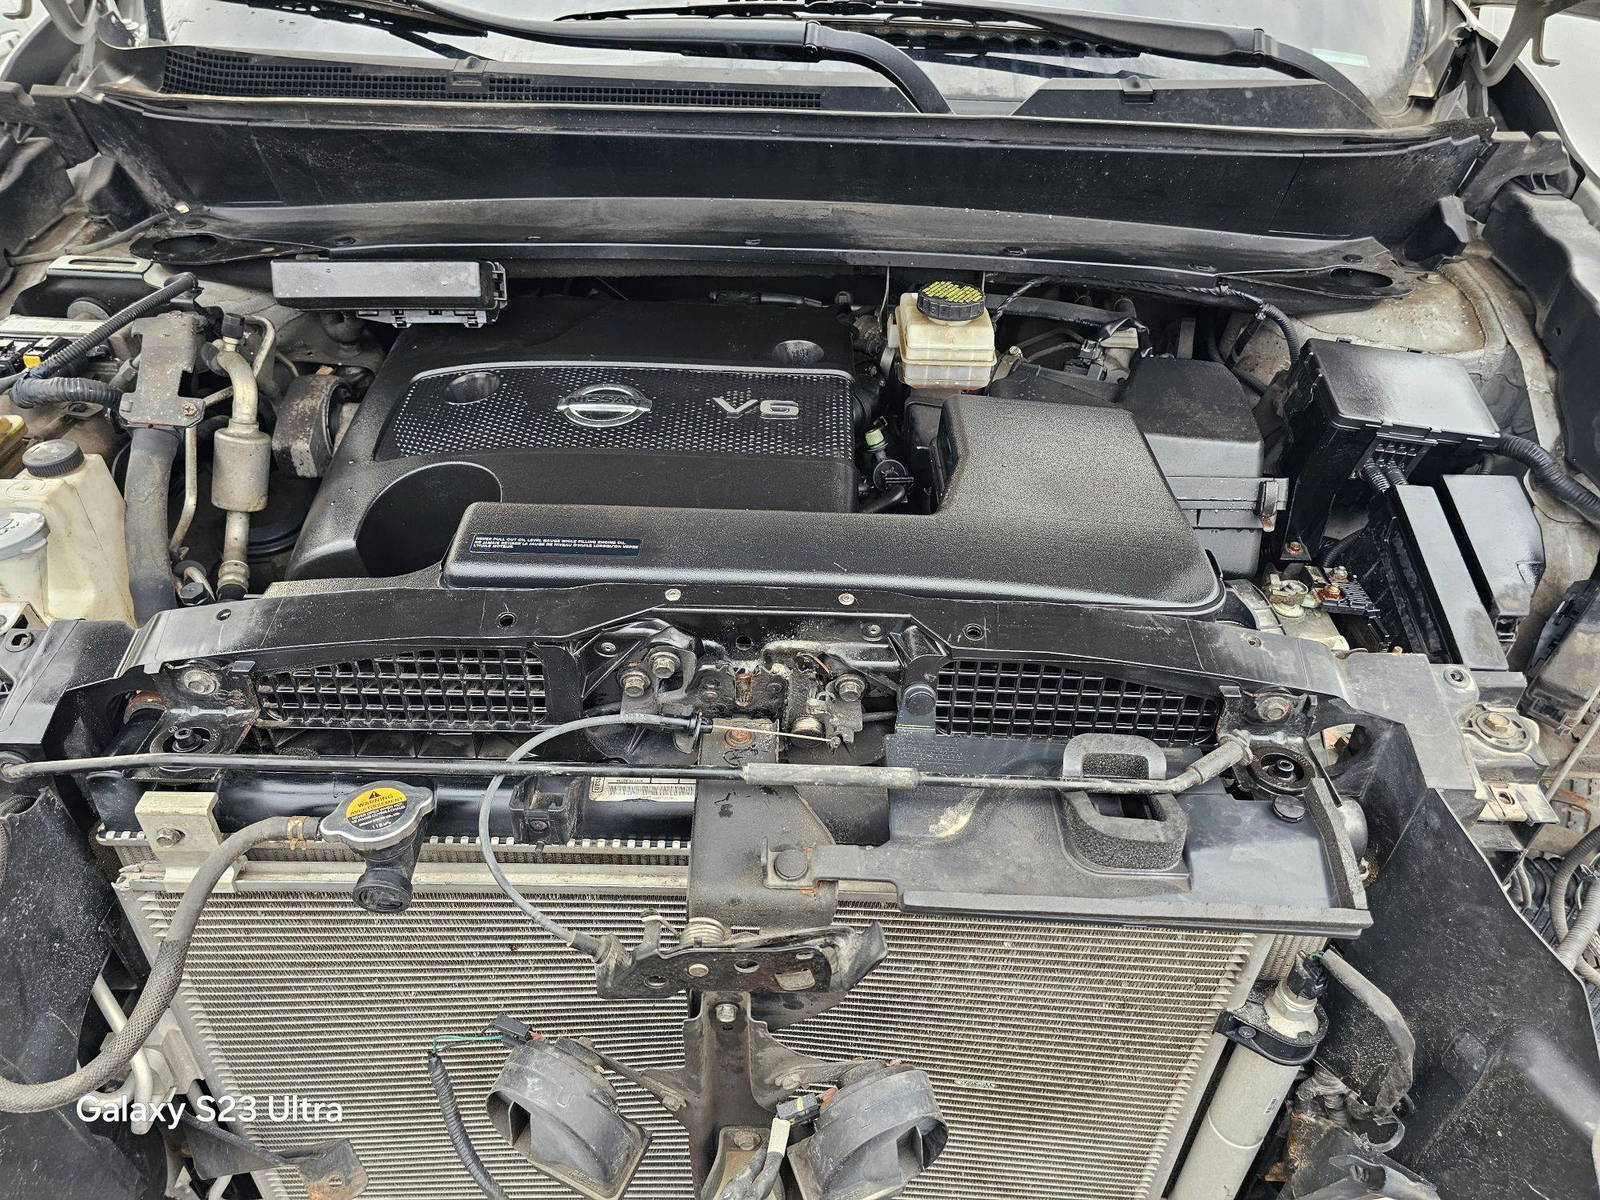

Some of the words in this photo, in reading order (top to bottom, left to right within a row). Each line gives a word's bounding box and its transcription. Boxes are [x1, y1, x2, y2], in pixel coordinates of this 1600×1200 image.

[713, 397, 800, 419] V6
[350, 797, 403, 815] AVERTISSEMENT
[358, 794, 394, 808] WARNING
